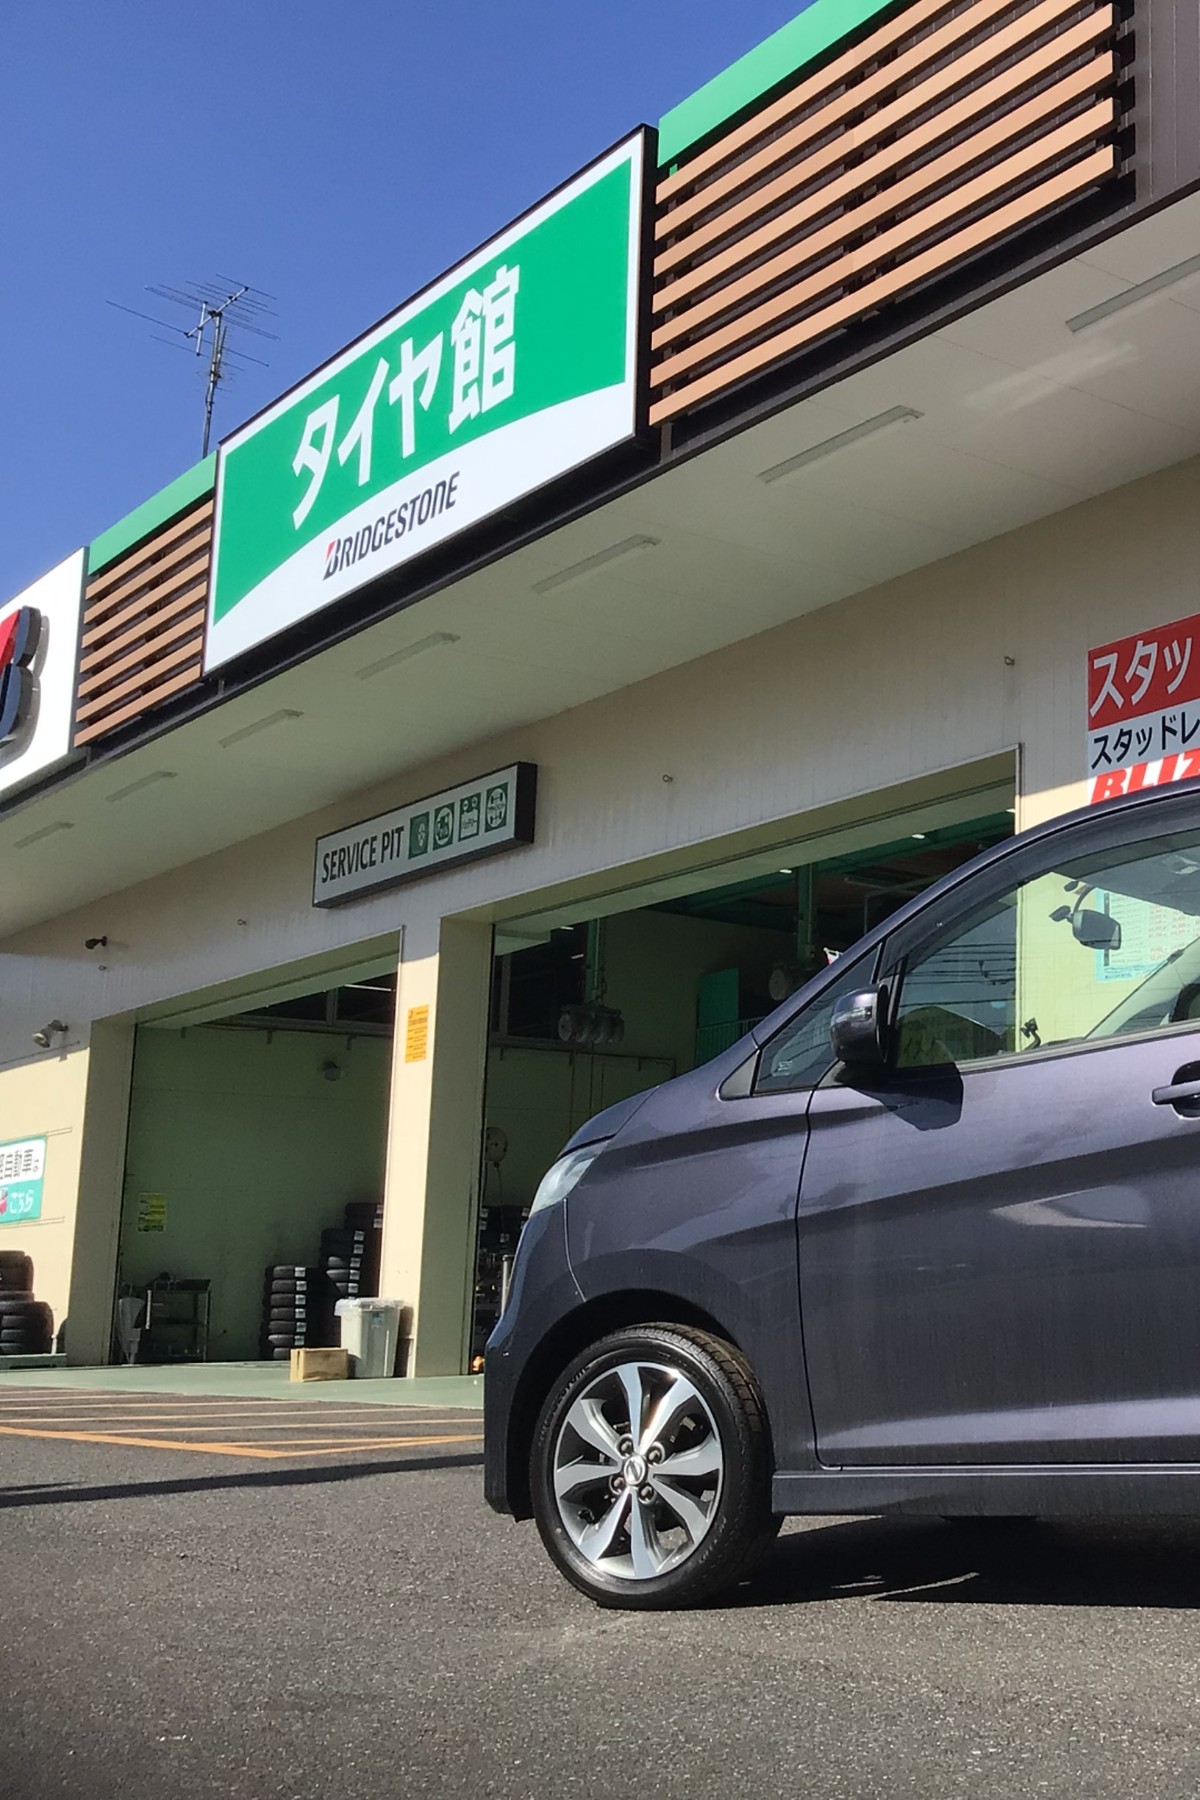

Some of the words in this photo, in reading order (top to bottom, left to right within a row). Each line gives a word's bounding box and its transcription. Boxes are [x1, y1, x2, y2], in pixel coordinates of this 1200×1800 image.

[292, 264, 520, 530] タイヤ館
[322, 470, 461, 580] BRIDGESTONE
[322, 833, 377, 883] SERVICE
[380, 826, 405, 863] PIT
